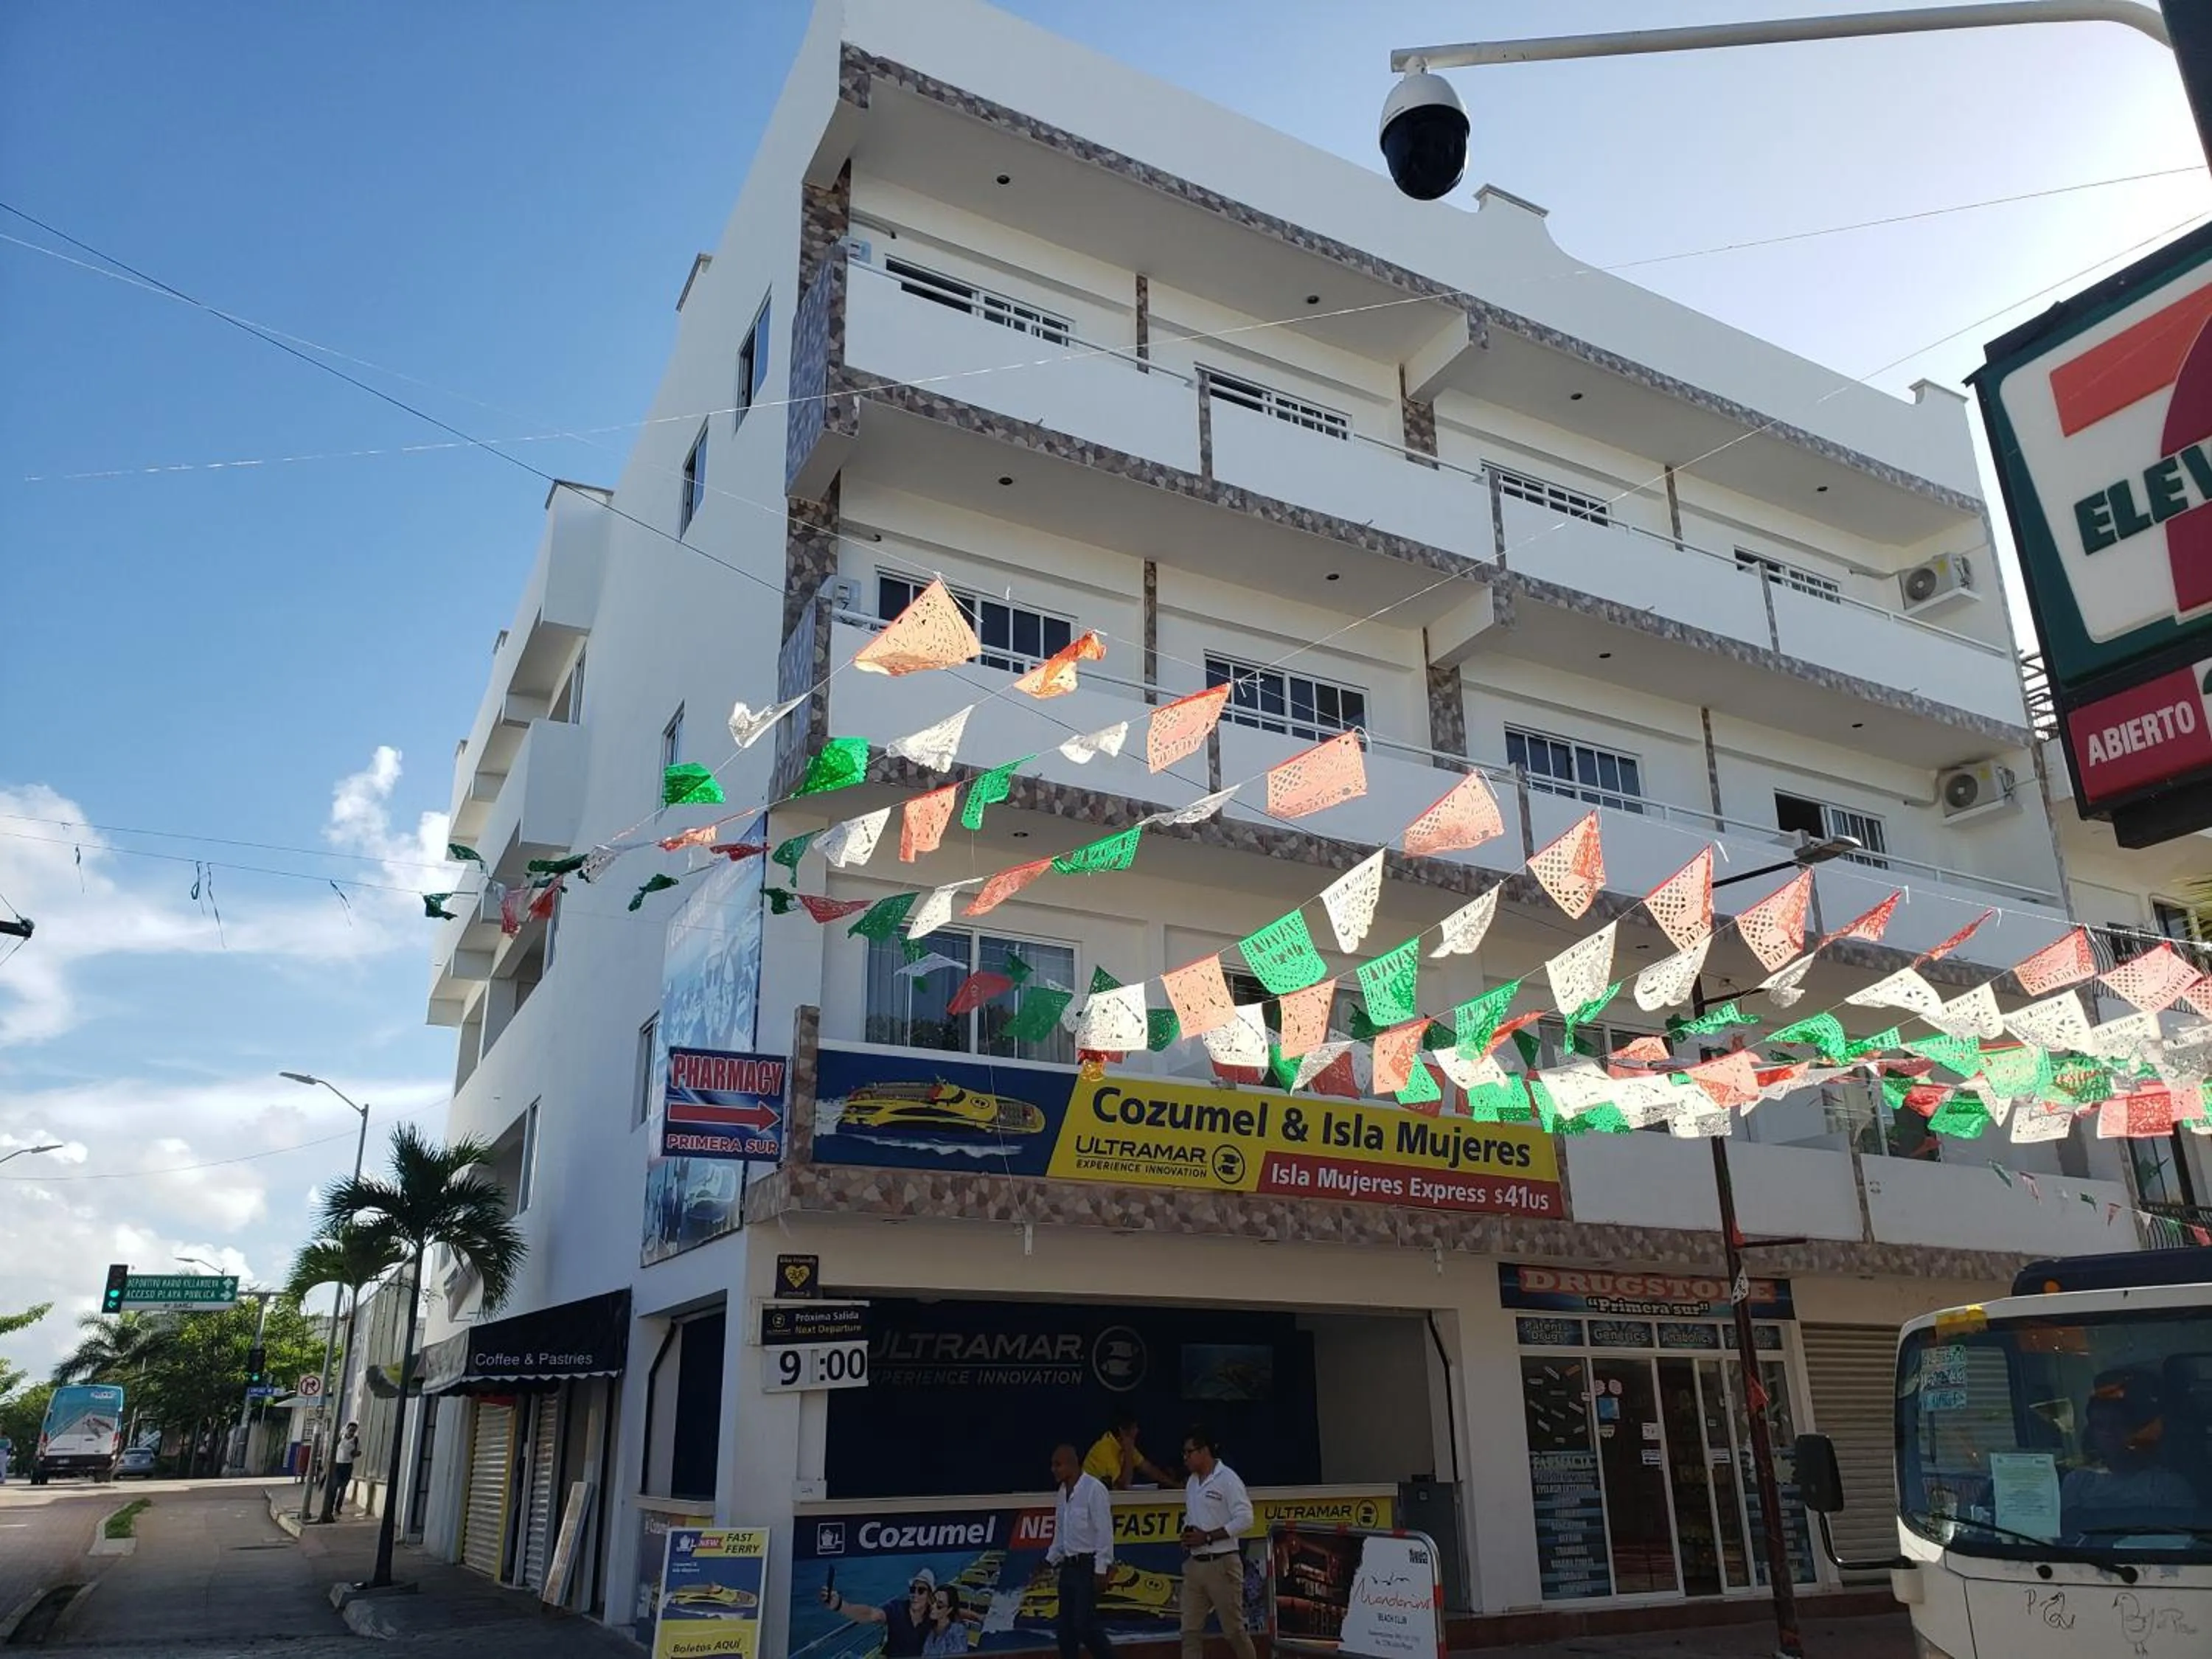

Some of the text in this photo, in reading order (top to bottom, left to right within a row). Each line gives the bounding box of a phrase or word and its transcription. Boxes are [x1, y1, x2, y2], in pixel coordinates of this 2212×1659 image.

[2088, 700, 2196, 767] ABIERTO
[670, 1054, 785, 1096] PHARMACY
[1092, 1086, 1531, 1169] Cozumel & Isla Mujeres
[666, 1133, 779, 1155] PRIMERA SUR
[1075, 1134, 1207, 1164] ULTRAMAR
[1075, 1158, 1207, 1178] EXPERIENCE INNOVATION
[1271, 1162, 1310, 1186] Isla
[1317, 1167, 1402, 1197] Mujeres
[1409, 1177, 1486, 1204] Express
[125, 1290, 155, 1299] ACCESO
[156, 1290, 181, 1299] PLAYA
[832, 1310, 860, 1321] Salida
[795, 1325, 816, 1335] Next
[818, 1324, 862, 1335] Departure
[475, 1352, 594, 1366] Coffee & Pastries
[976, 1368, 1082, 1385] INNOVATION
[1265, 1504, 1352, 1520] ULTRAMAR
[725, 1533, 754, 1543] FAST
[858, 1515, 998, 1549] Cozumel
[1020, 1515, 1056, 1540] NE
[1113, 1512, 1171, 1538] FAST
[725, 1544, 760, 1554] FERRY
[673, 1643, 712, 1653] Boletos
